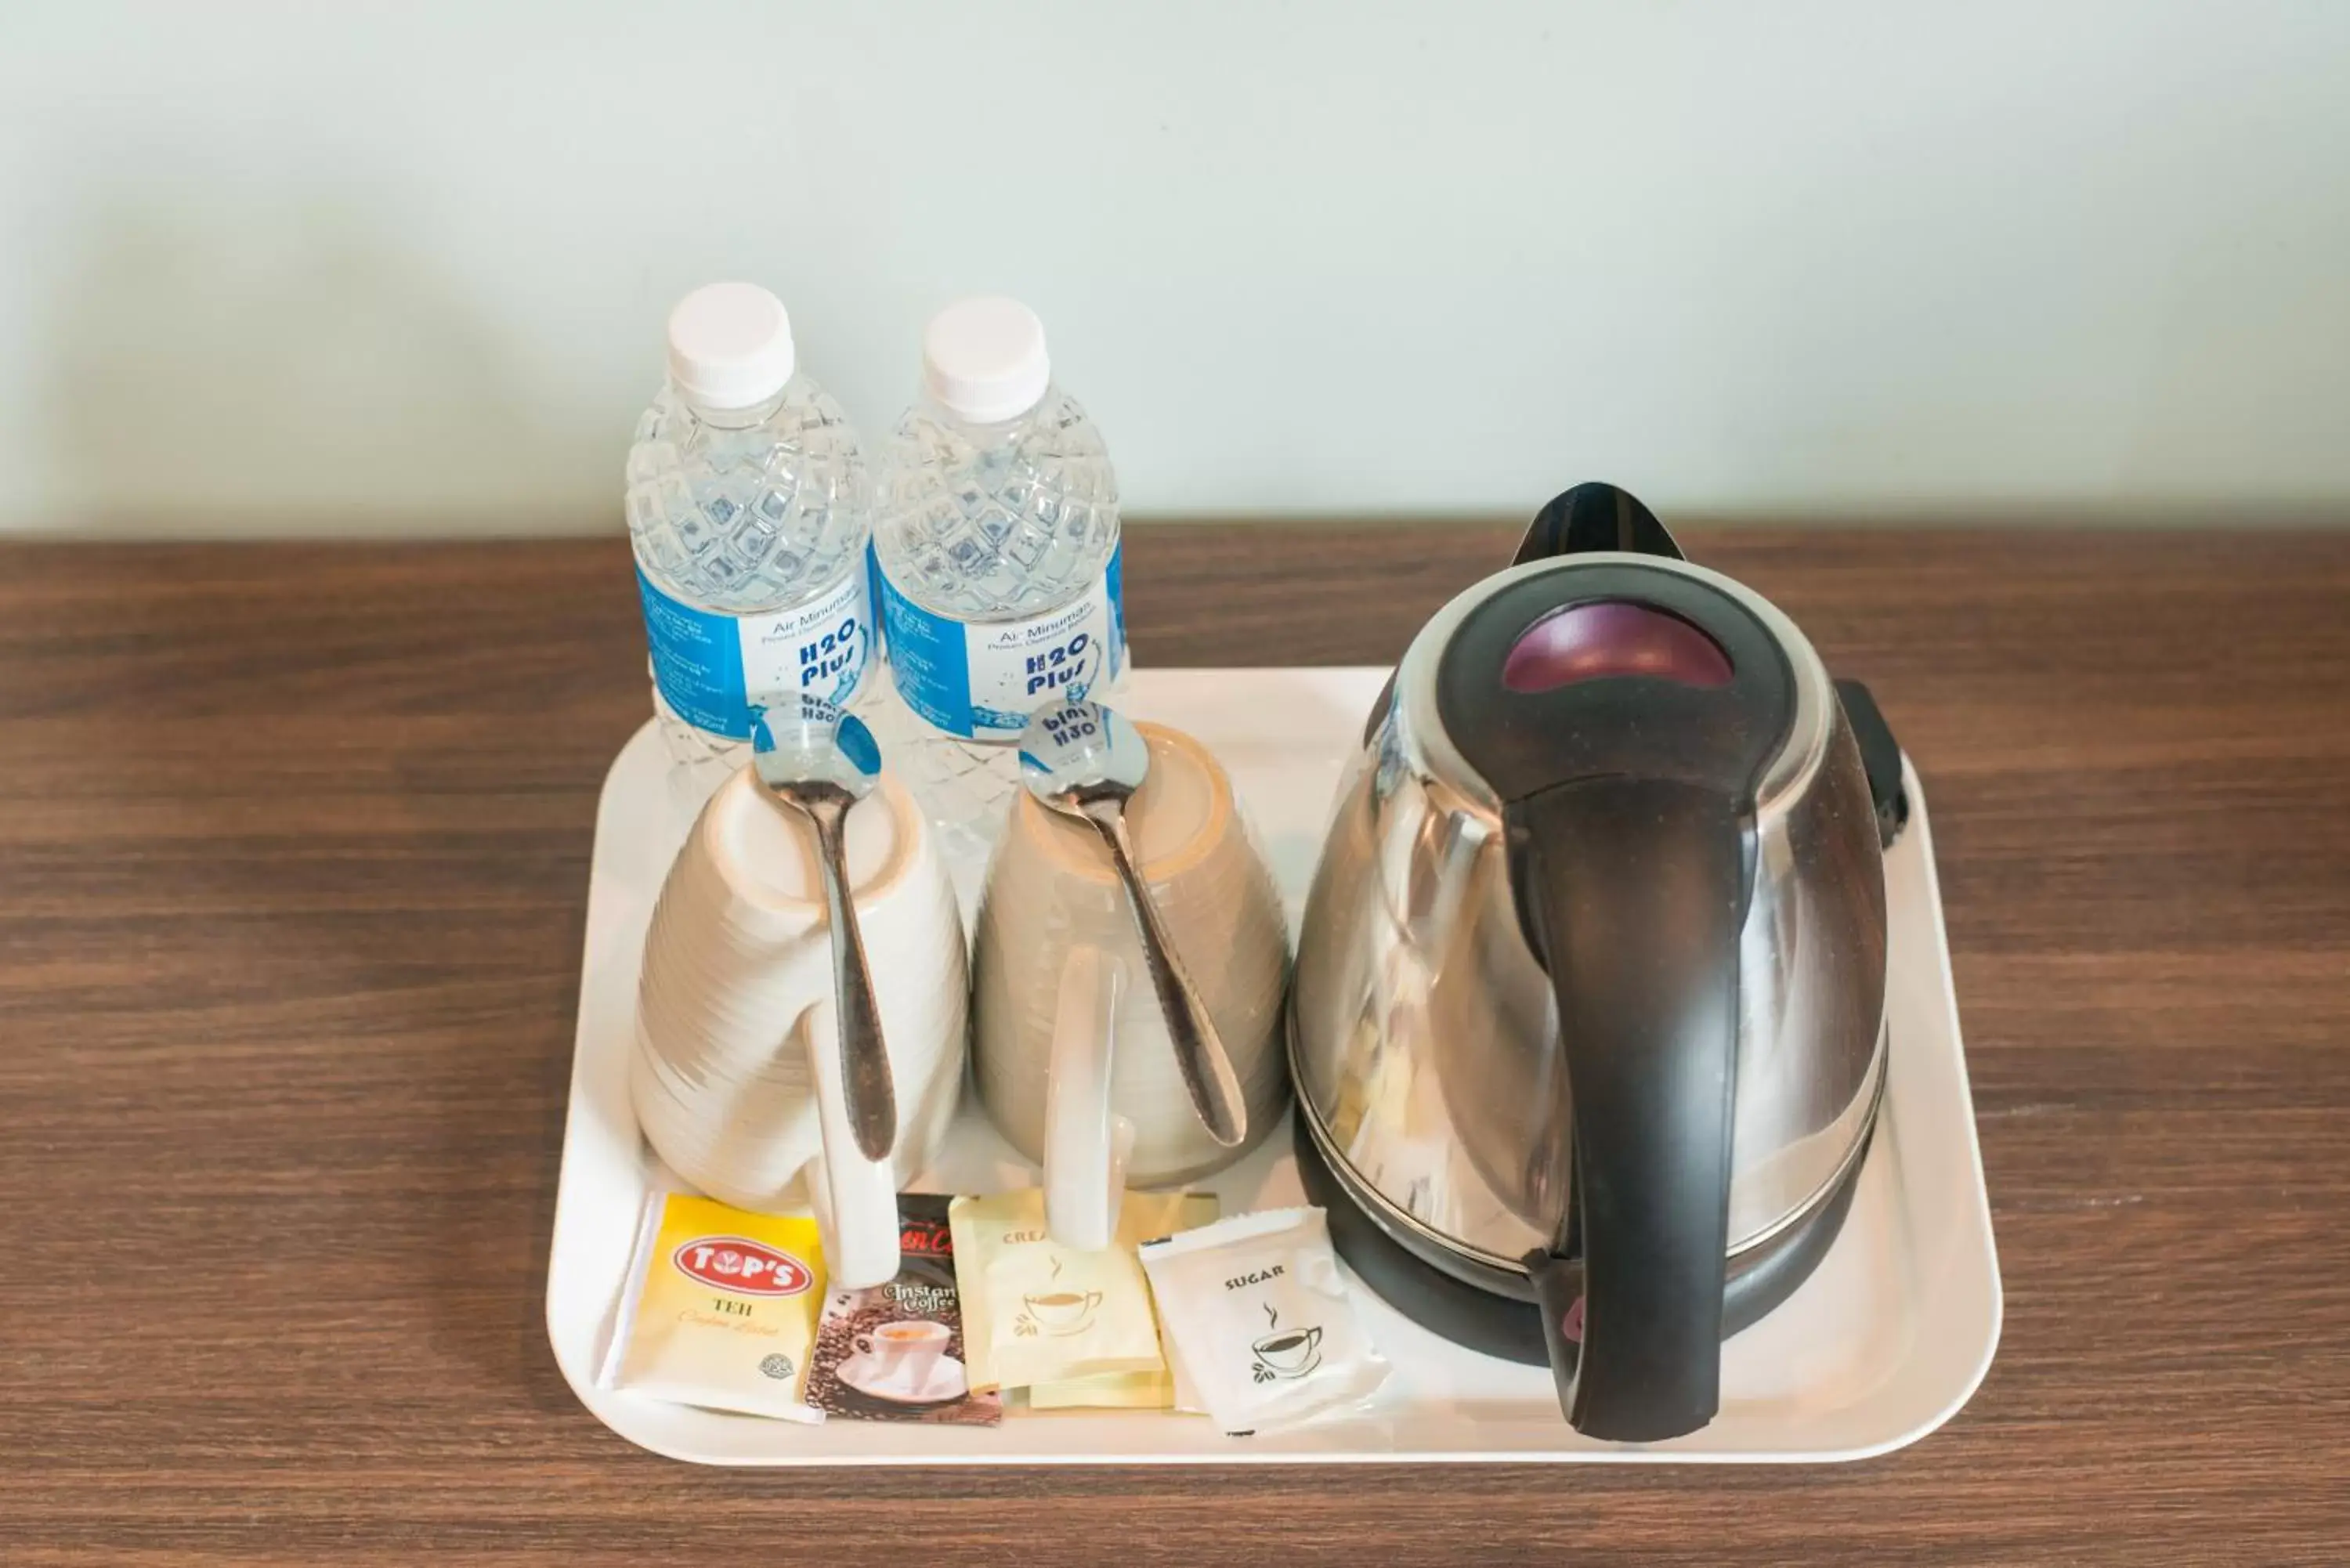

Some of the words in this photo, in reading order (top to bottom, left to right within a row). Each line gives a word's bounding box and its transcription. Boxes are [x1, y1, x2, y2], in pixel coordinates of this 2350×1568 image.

[799, 618, 855, 665] H2O
[1026, 633, 1089, 674] H2O
[694, 1248, 794, 1286] TOP'S
[1224, 1265, 1285, 1292] SUGAR
[893, 1284, 956, 1300] Instan
[903, 1298, 955, 1312] Coffee
[713, 1298, 752, 1317] TEH
